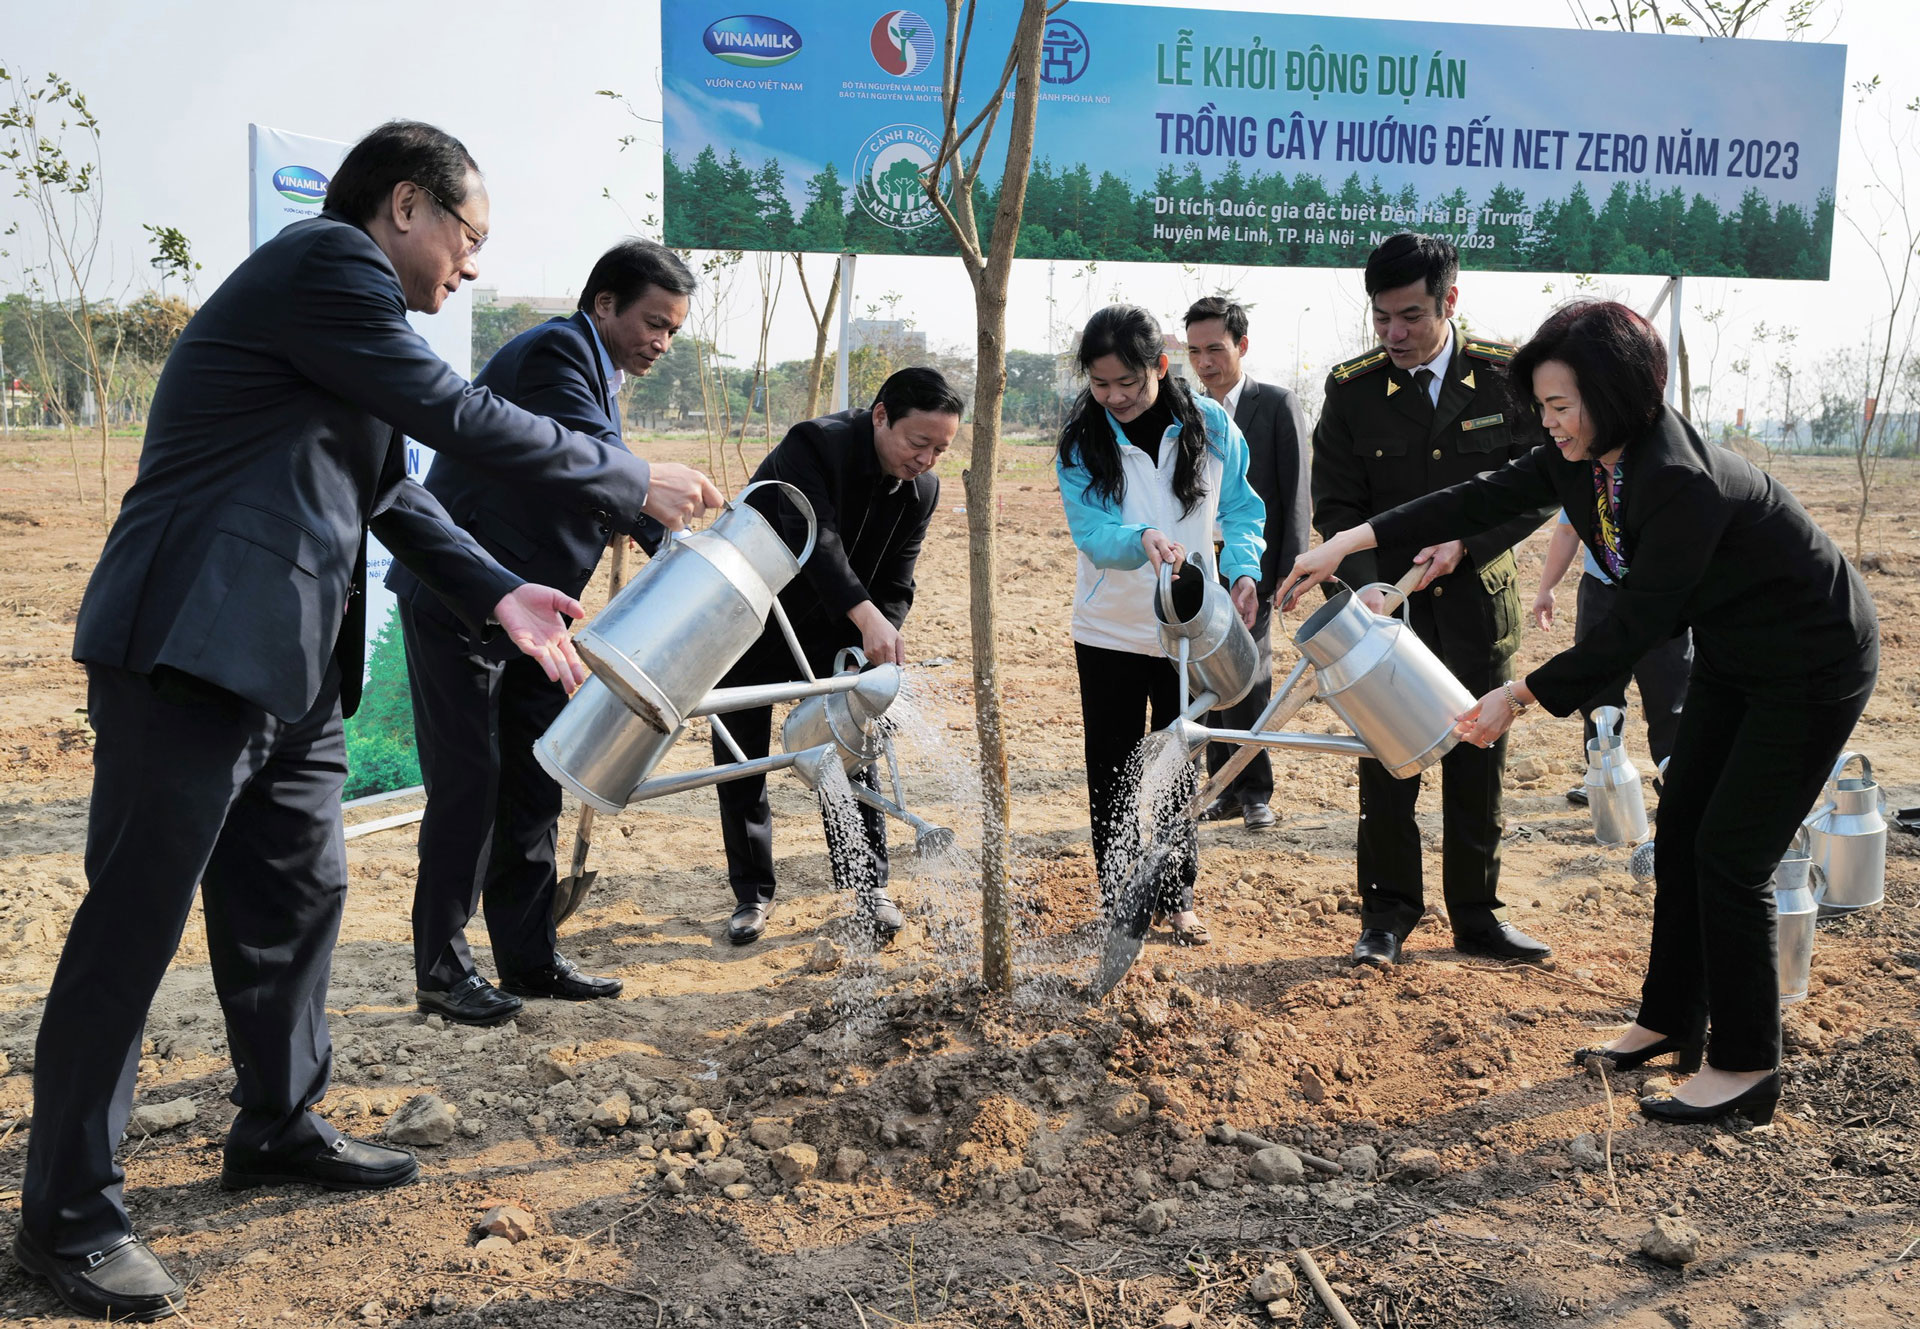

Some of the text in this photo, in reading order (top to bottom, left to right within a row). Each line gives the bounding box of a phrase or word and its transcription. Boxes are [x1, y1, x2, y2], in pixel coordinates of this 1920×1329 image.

[713, 31, 794, 49] VINAMILK
[1158, 29, 1466, 105] LỄ KHỞI ĐỘNG DỰ ÁN
[705, 78, 803, 91] VƯƠN CAO VIỆT NAM
[870, 130, 939, 155] CẢNH RỪNG
[1155, 102, 1799, 179] TRỒNG CÂY HƯỚNG ĐẾN NET ZERO NĂM 2023
[278, 175, 327, 192] VINAMILK
[869, 199, 898, 222] NET
[1154, 196, 1174, 214] Di
[1179, 197, 1214, 216] tích
[1219, 198, 1267, 218] Quốc
[1271, 202, 1299, 223] gia
[1304, 202, 1336, 224] đặc
[1341, 203, 1376, 225] biệt
[1421, 206, 1450, 223] Hai
[1482, 208, 1534, 231] Trưng
[1153, 224, 1203, 243] Huyện
[1208, 226, 1231, 241] Mê
[1235, 227, 1273, 245] Linh,
[1277, 228, 1300, 243] TP.
[1305, 228, 1324, 244] Hà
[1329, 229, 1354, 248] Nội
